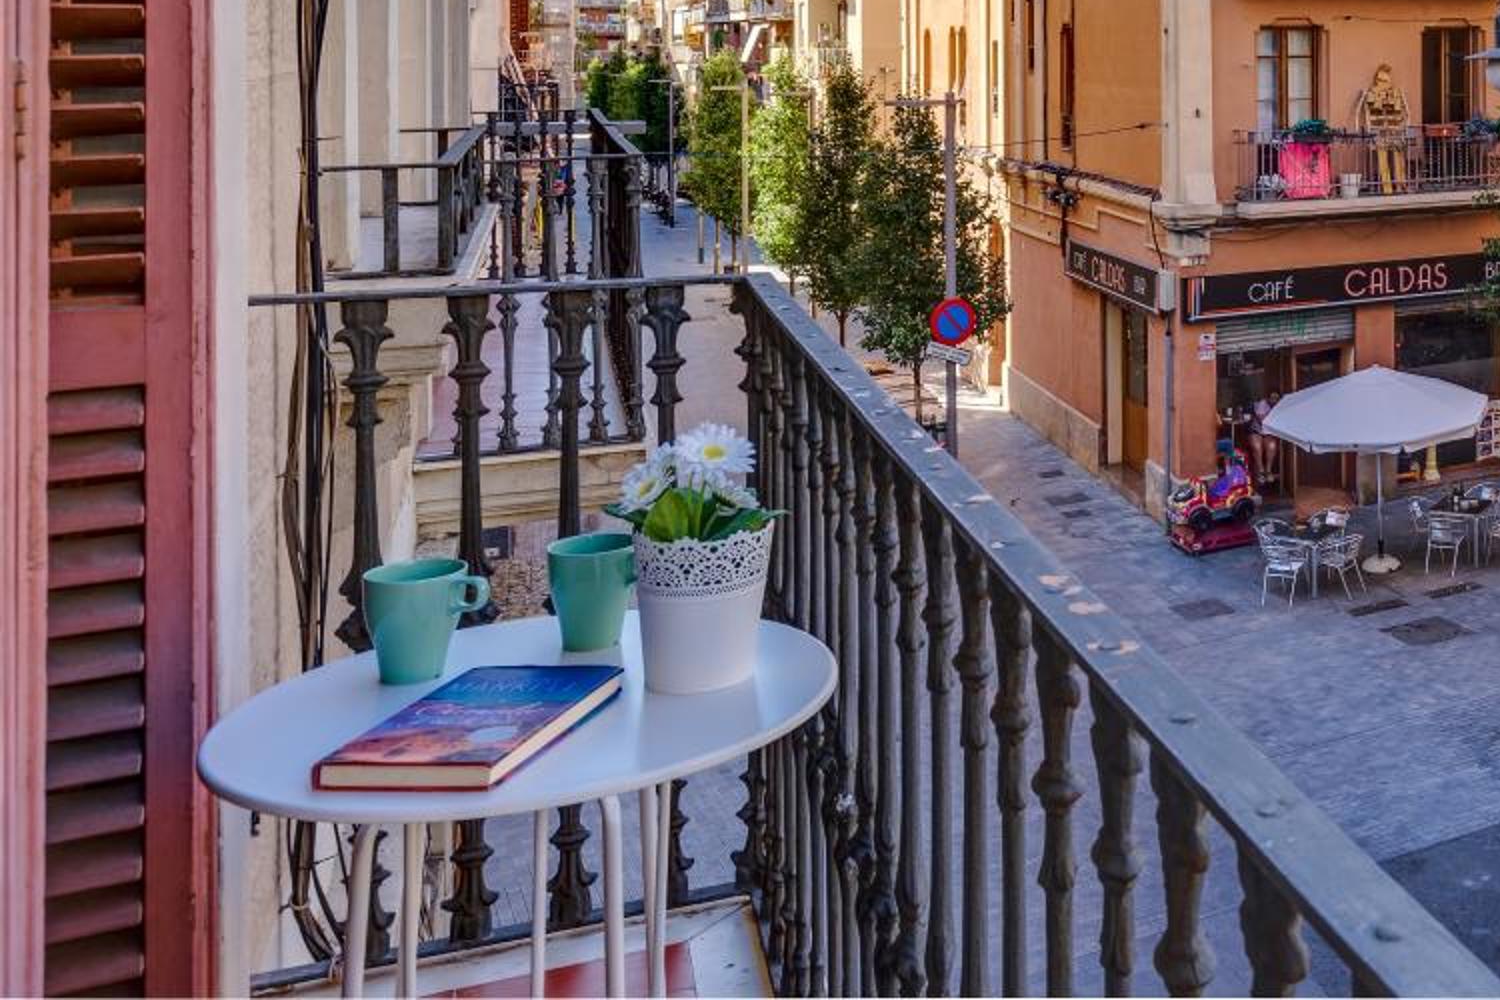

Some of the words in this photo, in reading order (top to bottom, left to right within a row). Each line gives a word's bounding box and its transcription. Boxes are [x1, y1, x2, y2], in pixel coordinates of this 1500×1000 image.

[1091, 256, 1126, 293] CALDAS
[1248, 275, 1294, 303] CAFÉ
[1344, 263, 1448, 297] CALDAS
